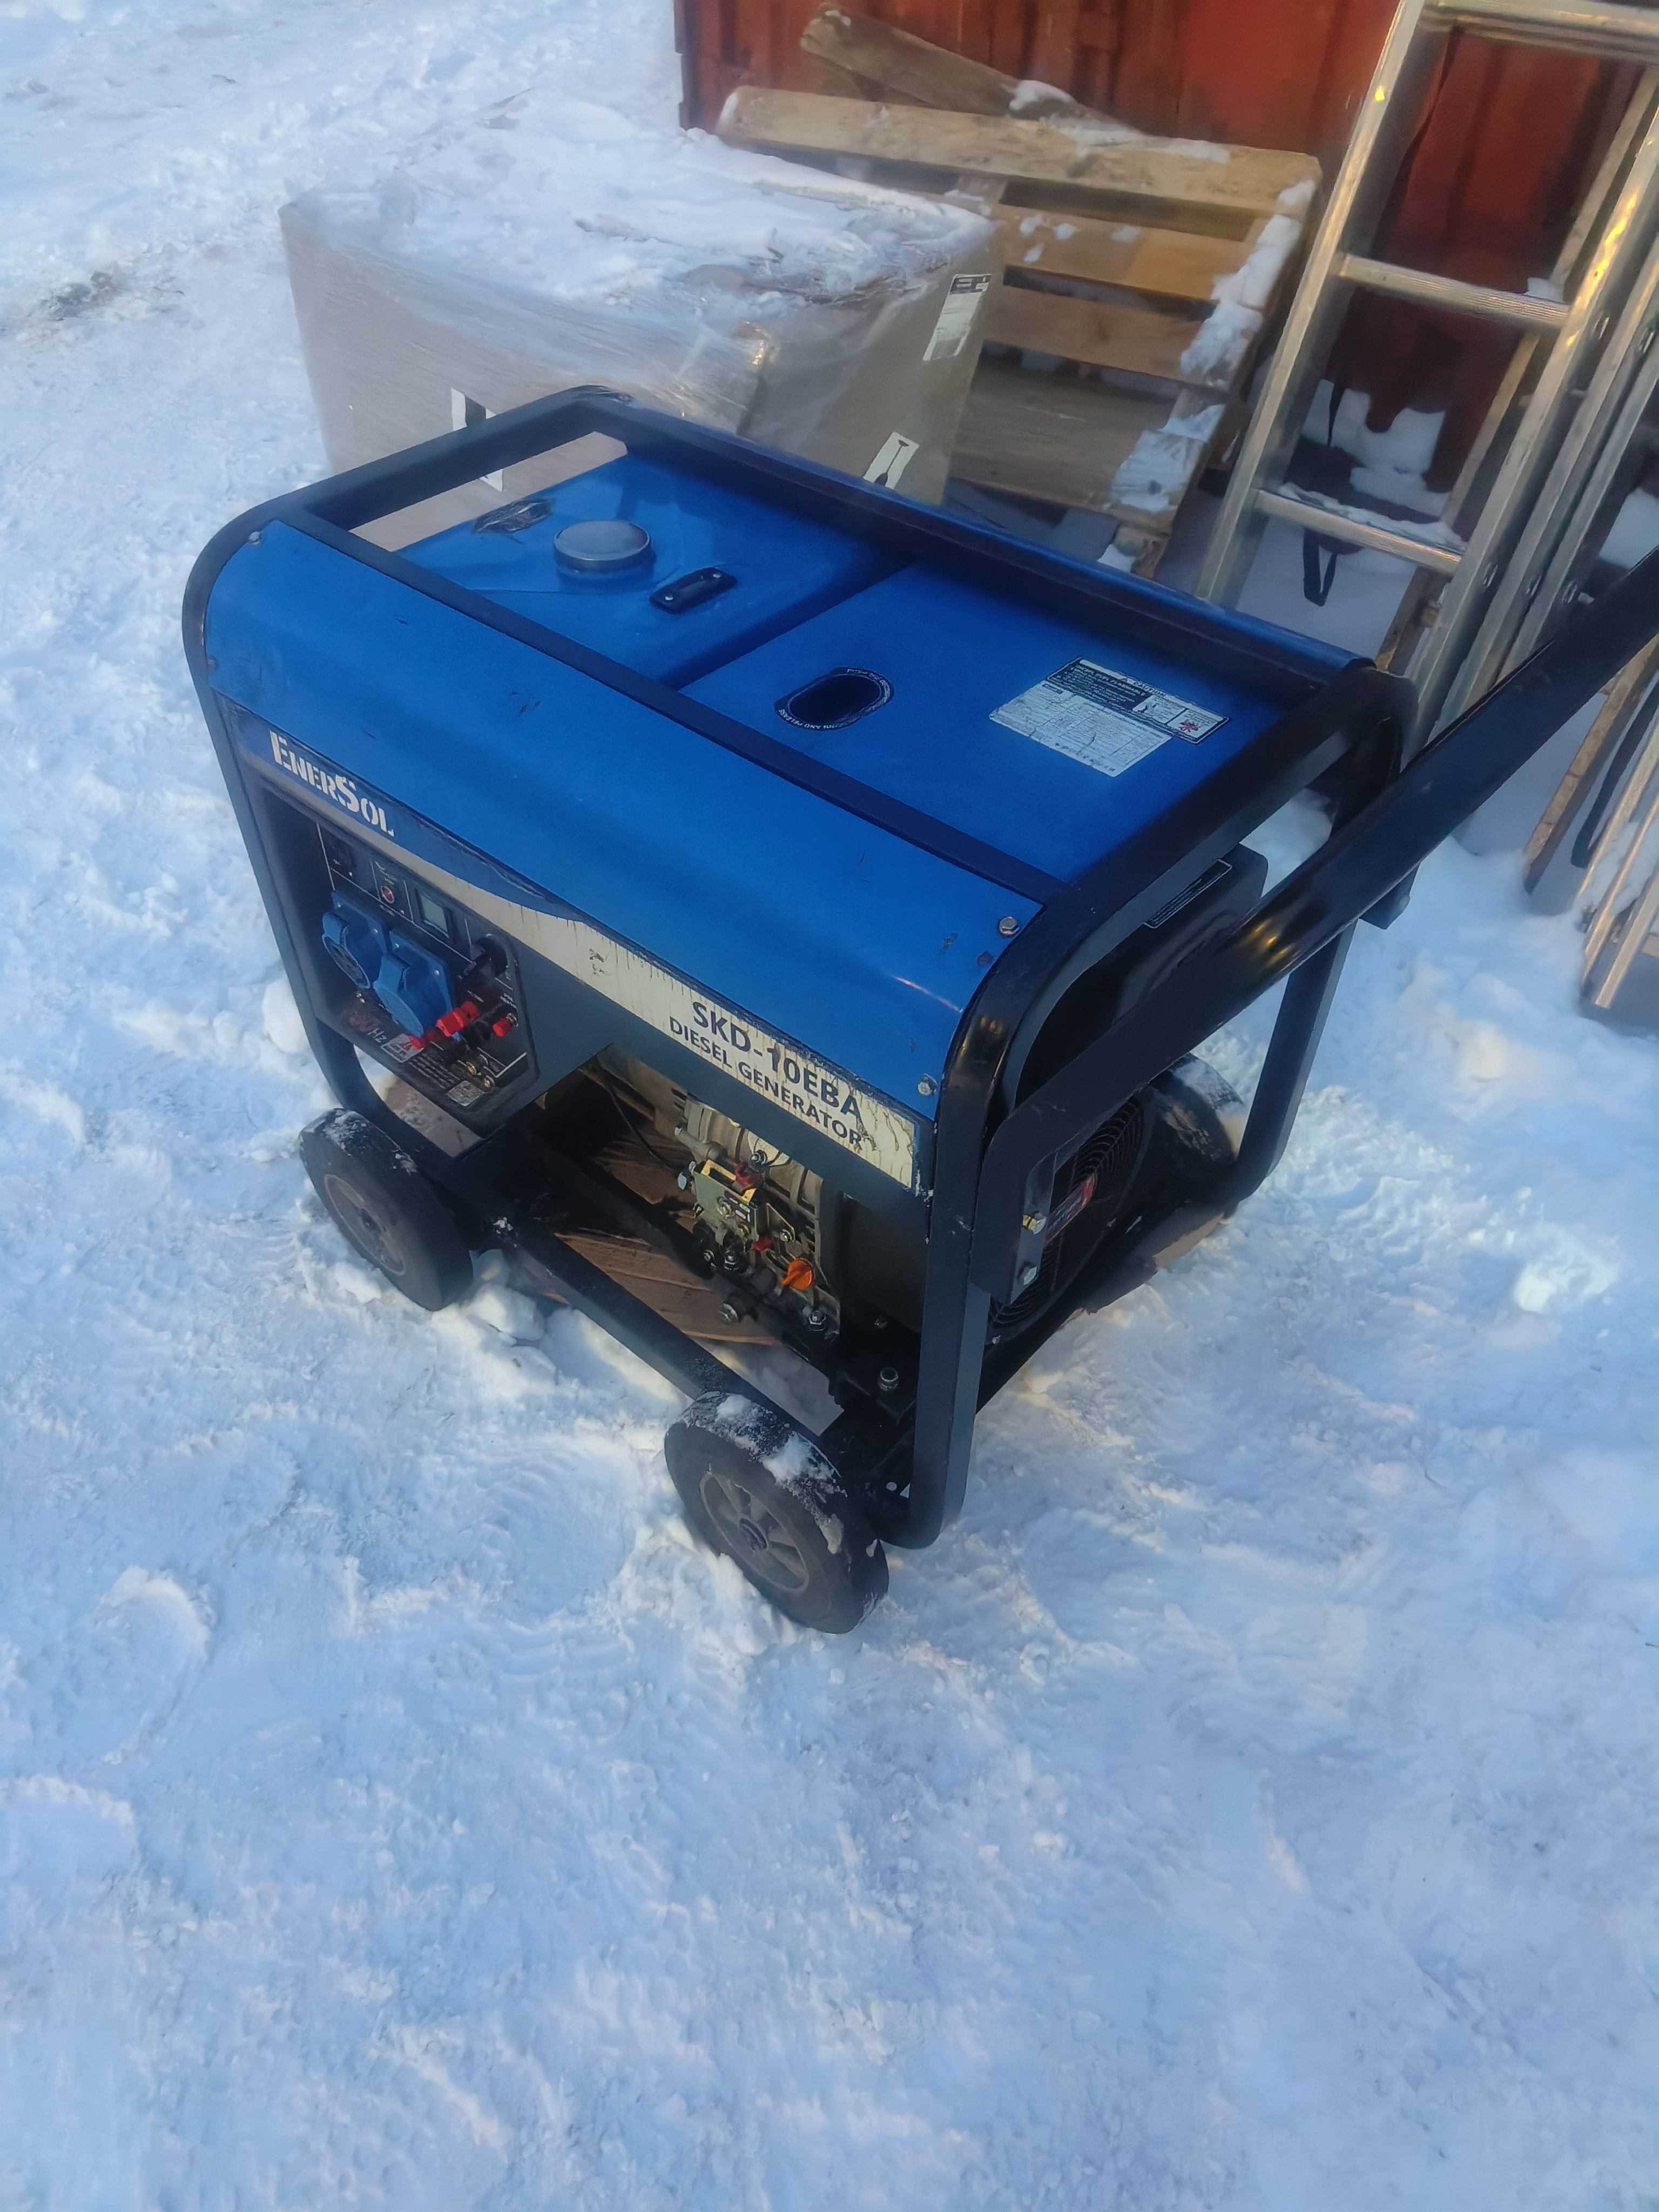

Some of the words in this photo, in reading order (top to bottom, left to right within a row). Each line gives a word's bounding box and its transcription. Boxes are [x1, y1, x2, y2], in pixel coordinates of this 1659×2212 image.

[669, 1015, 733, 1069] DIESEL
[738, 1061, 862, 1152] GENERATOR
[692, 1001, 865, 1129] SKD-10EBA
